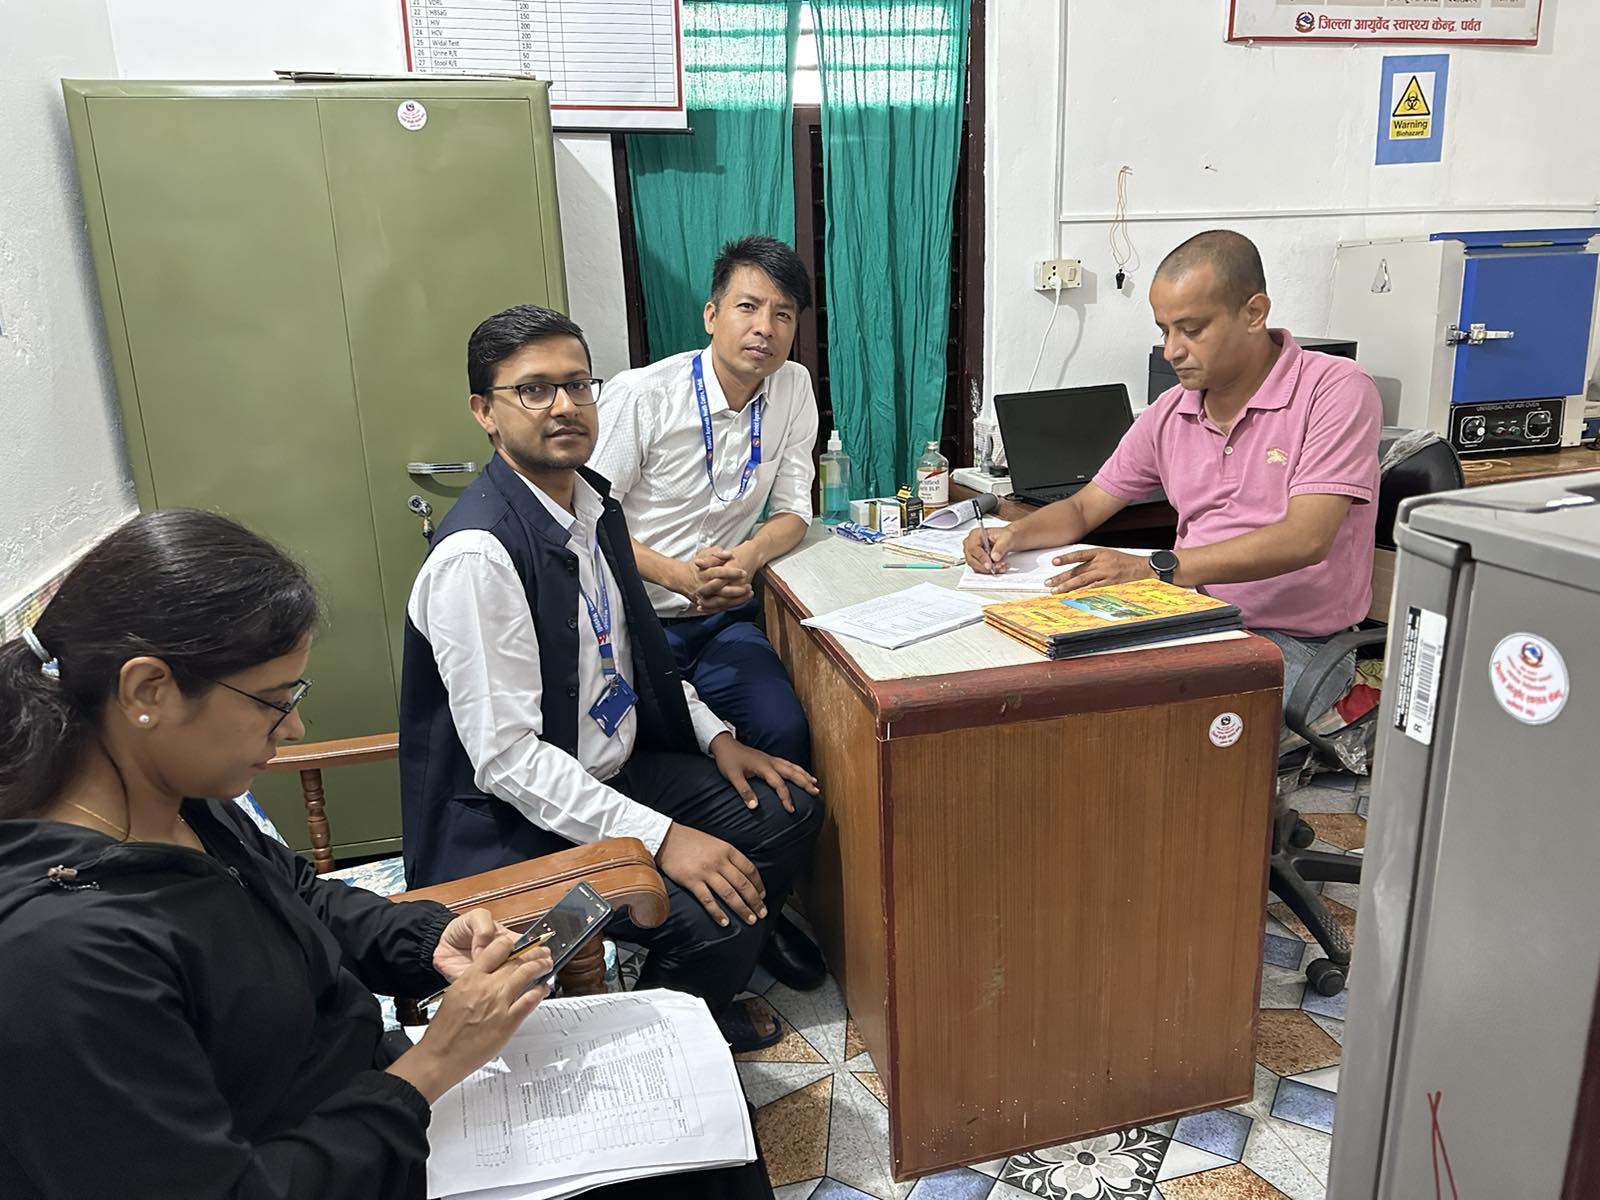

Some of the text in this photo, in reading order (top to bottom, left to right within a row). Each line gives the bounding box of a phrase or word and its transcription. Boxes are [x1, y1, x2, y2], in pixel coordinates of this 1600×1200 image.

[1318, 15, 1351, 30] जिल्ला
[1354, 16, 1390, 33] आयुर्वेद
[1393, 19, 1429, 31] स्वास्थ्य
[1461, 18, 1481, 32] पर्वत
[1393, 120, 1428, 129] Warning
